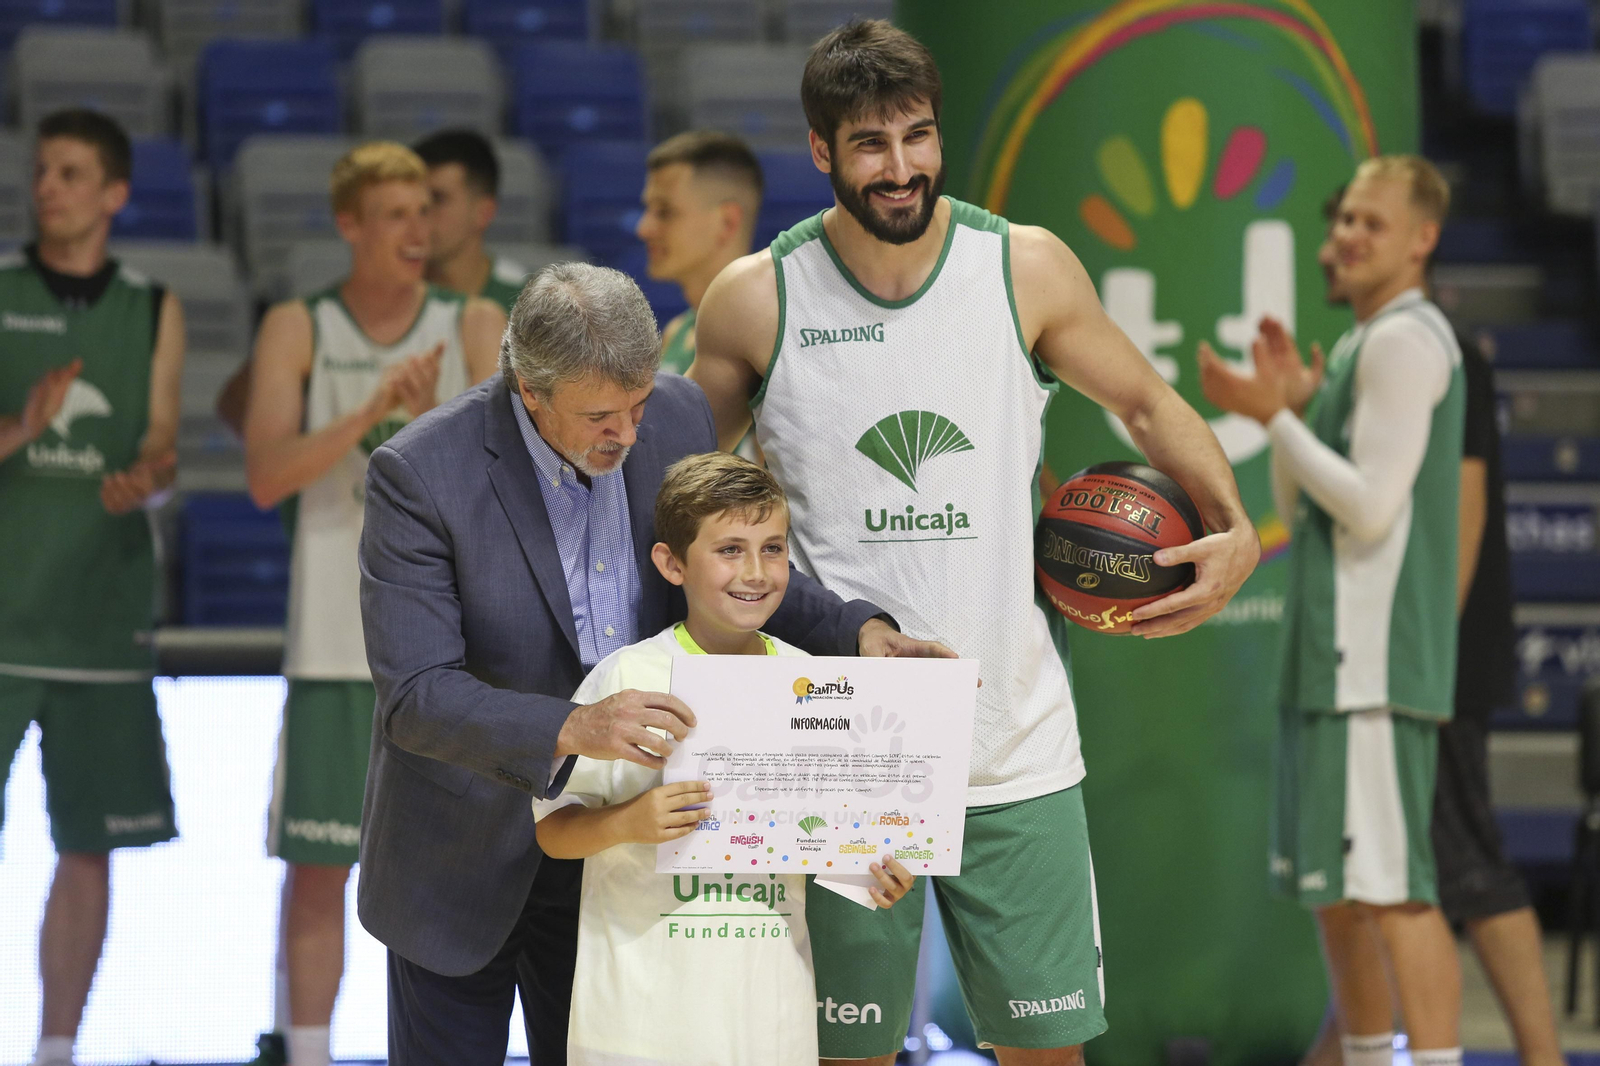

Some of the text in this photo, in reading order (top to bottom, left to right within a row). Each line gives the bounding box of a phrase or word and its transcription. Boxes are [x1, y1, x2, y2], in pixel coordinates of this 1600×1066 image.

[800, 323, 885, 347] SPALDING
[1139, 491, 1156, 501] DEEP
[865, 503, 970, 535] Unicaja
[1060, 490, 1163, 536] TF-1000
[1043, 530, 1153, 583] SPALDING
[791, 716, 850, 731] INFORMACIÓN
[797, 837, 827, 845] Fundación
[673, 873, 787, 911] Unicaja
[1008, 989, 1085, 1019] SPALDING
